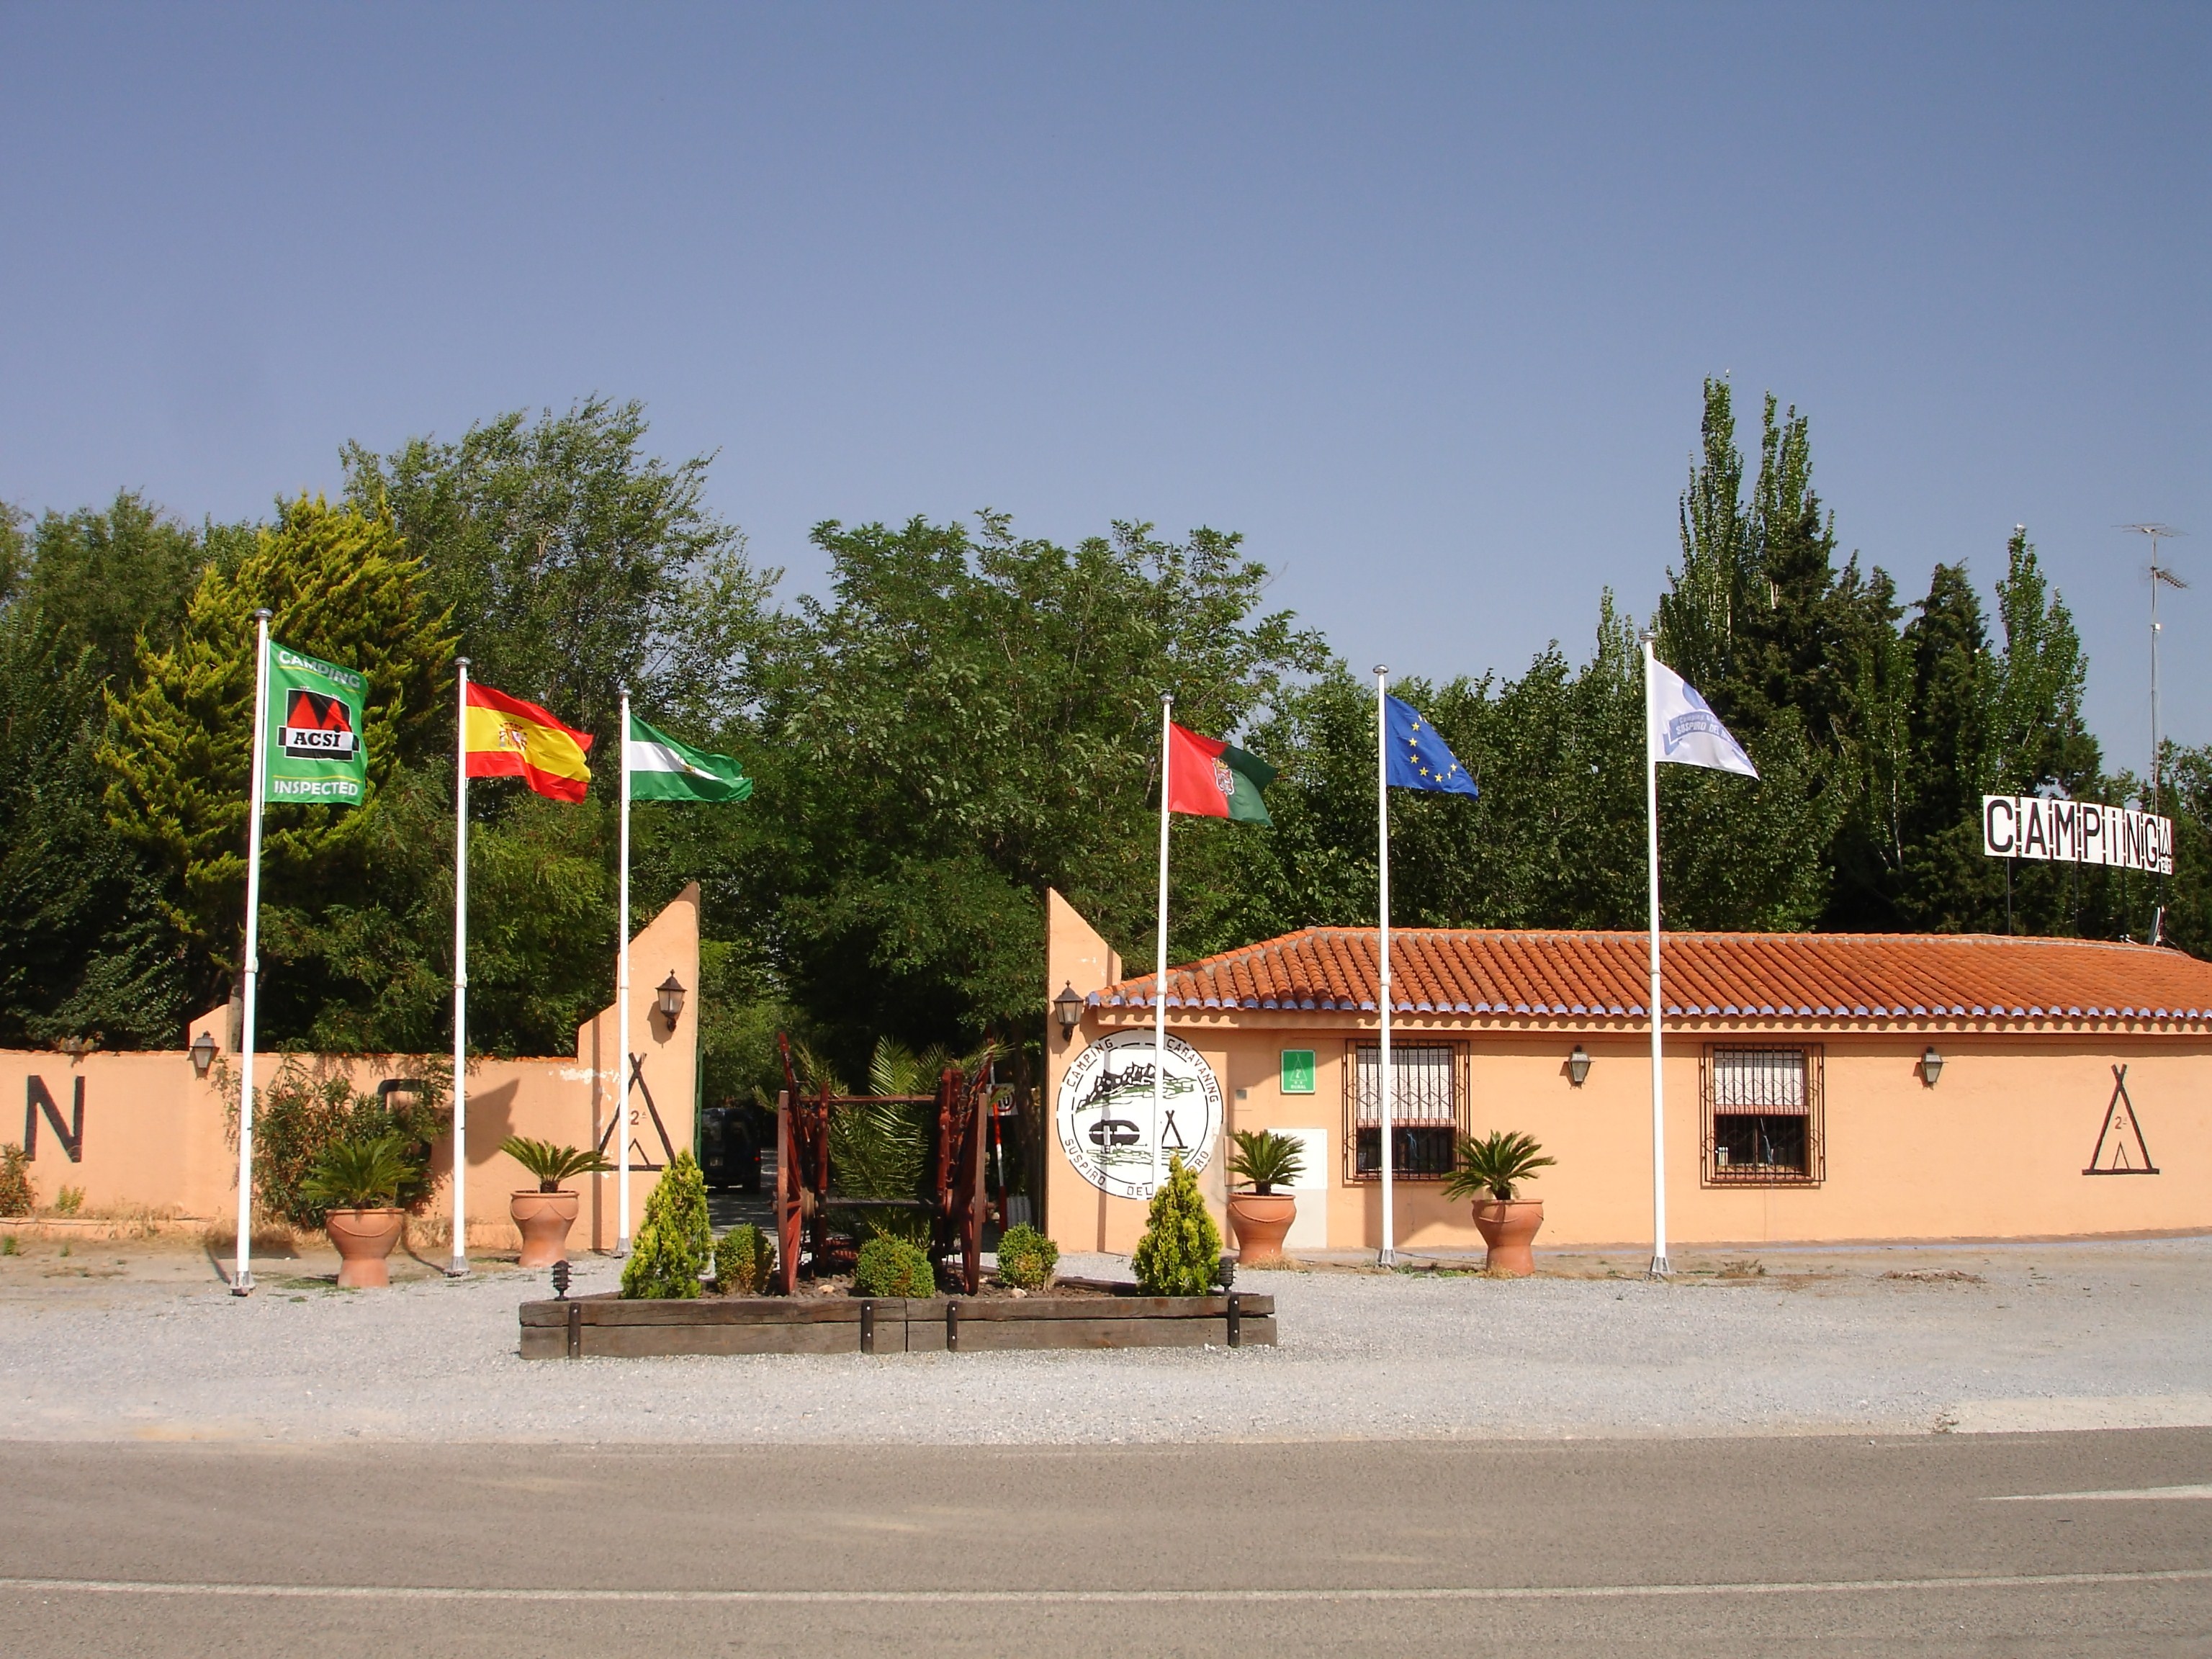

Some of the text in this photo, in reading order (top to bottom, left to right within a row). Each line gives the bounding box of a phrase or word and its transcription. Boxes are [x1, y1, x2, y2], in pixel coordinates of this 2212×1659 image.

[279, 651, 361, 688] CAMPING
[274, 781, 359, 796] INSPECTED
[1067, 1038, 1219, 1103] CAMPING CARAVANING
[1065, 1138, 1106, 1186] SUSPIRO
[1127, 1186, 1153, 1196] DEL
